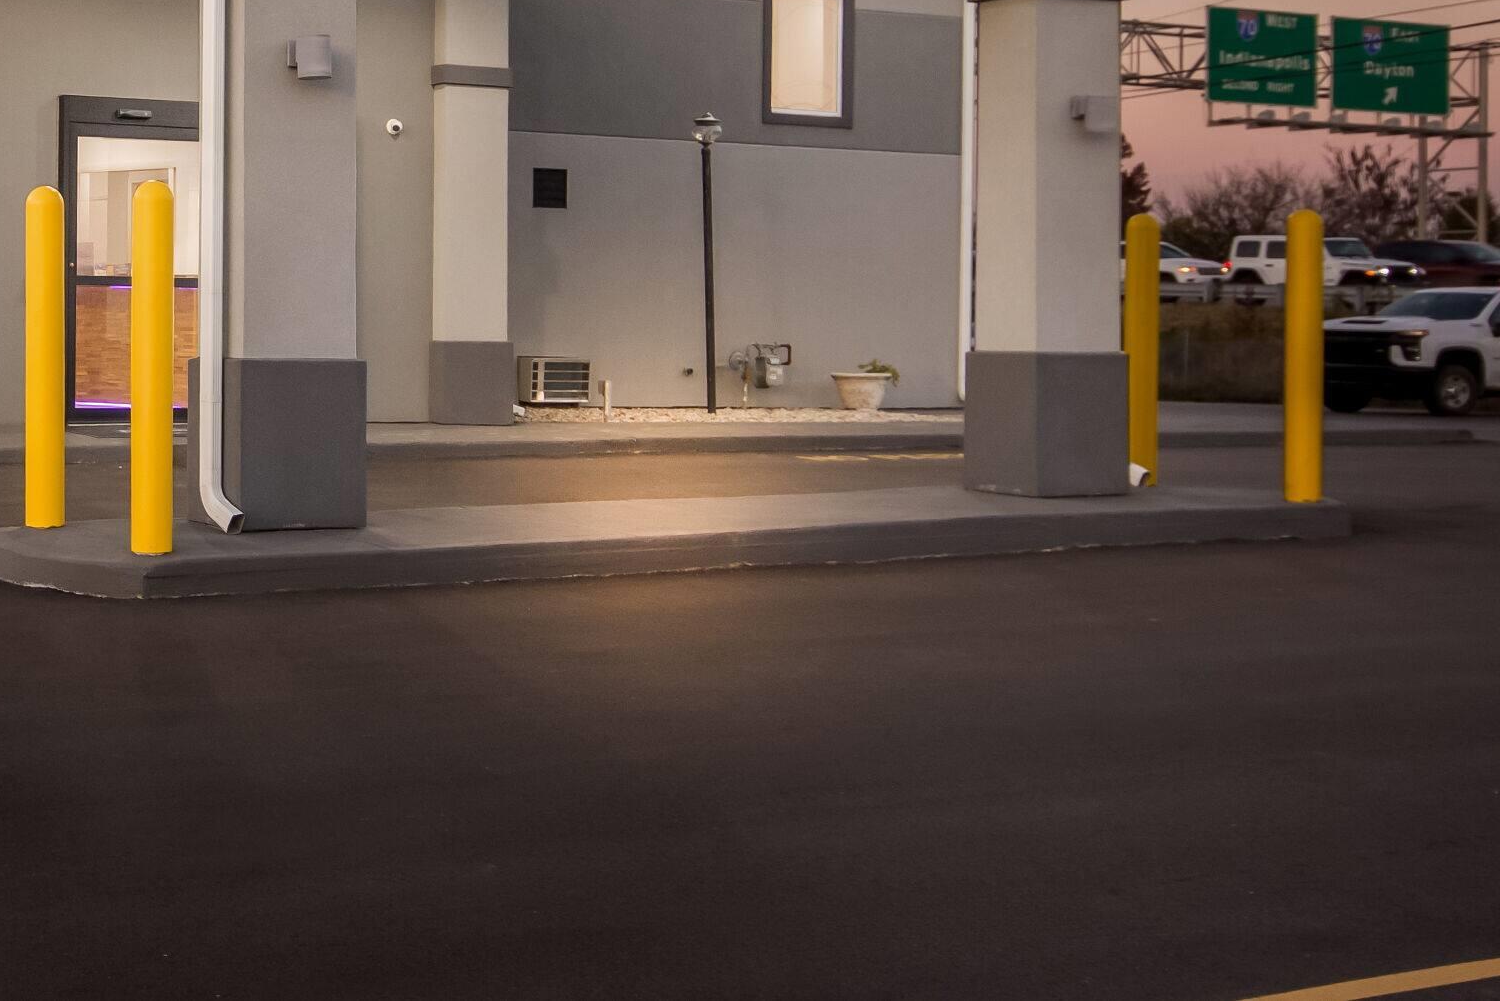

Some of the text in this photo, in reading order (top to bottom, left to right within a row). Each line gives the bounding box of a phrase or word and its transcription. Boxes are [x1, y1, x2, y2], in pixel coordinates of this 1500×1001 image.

[1238, 13, 1298, 36] 70 WEST
[1363, 32, 1381, 48] 70
[1363, 60, 1415, 80] Dayton
